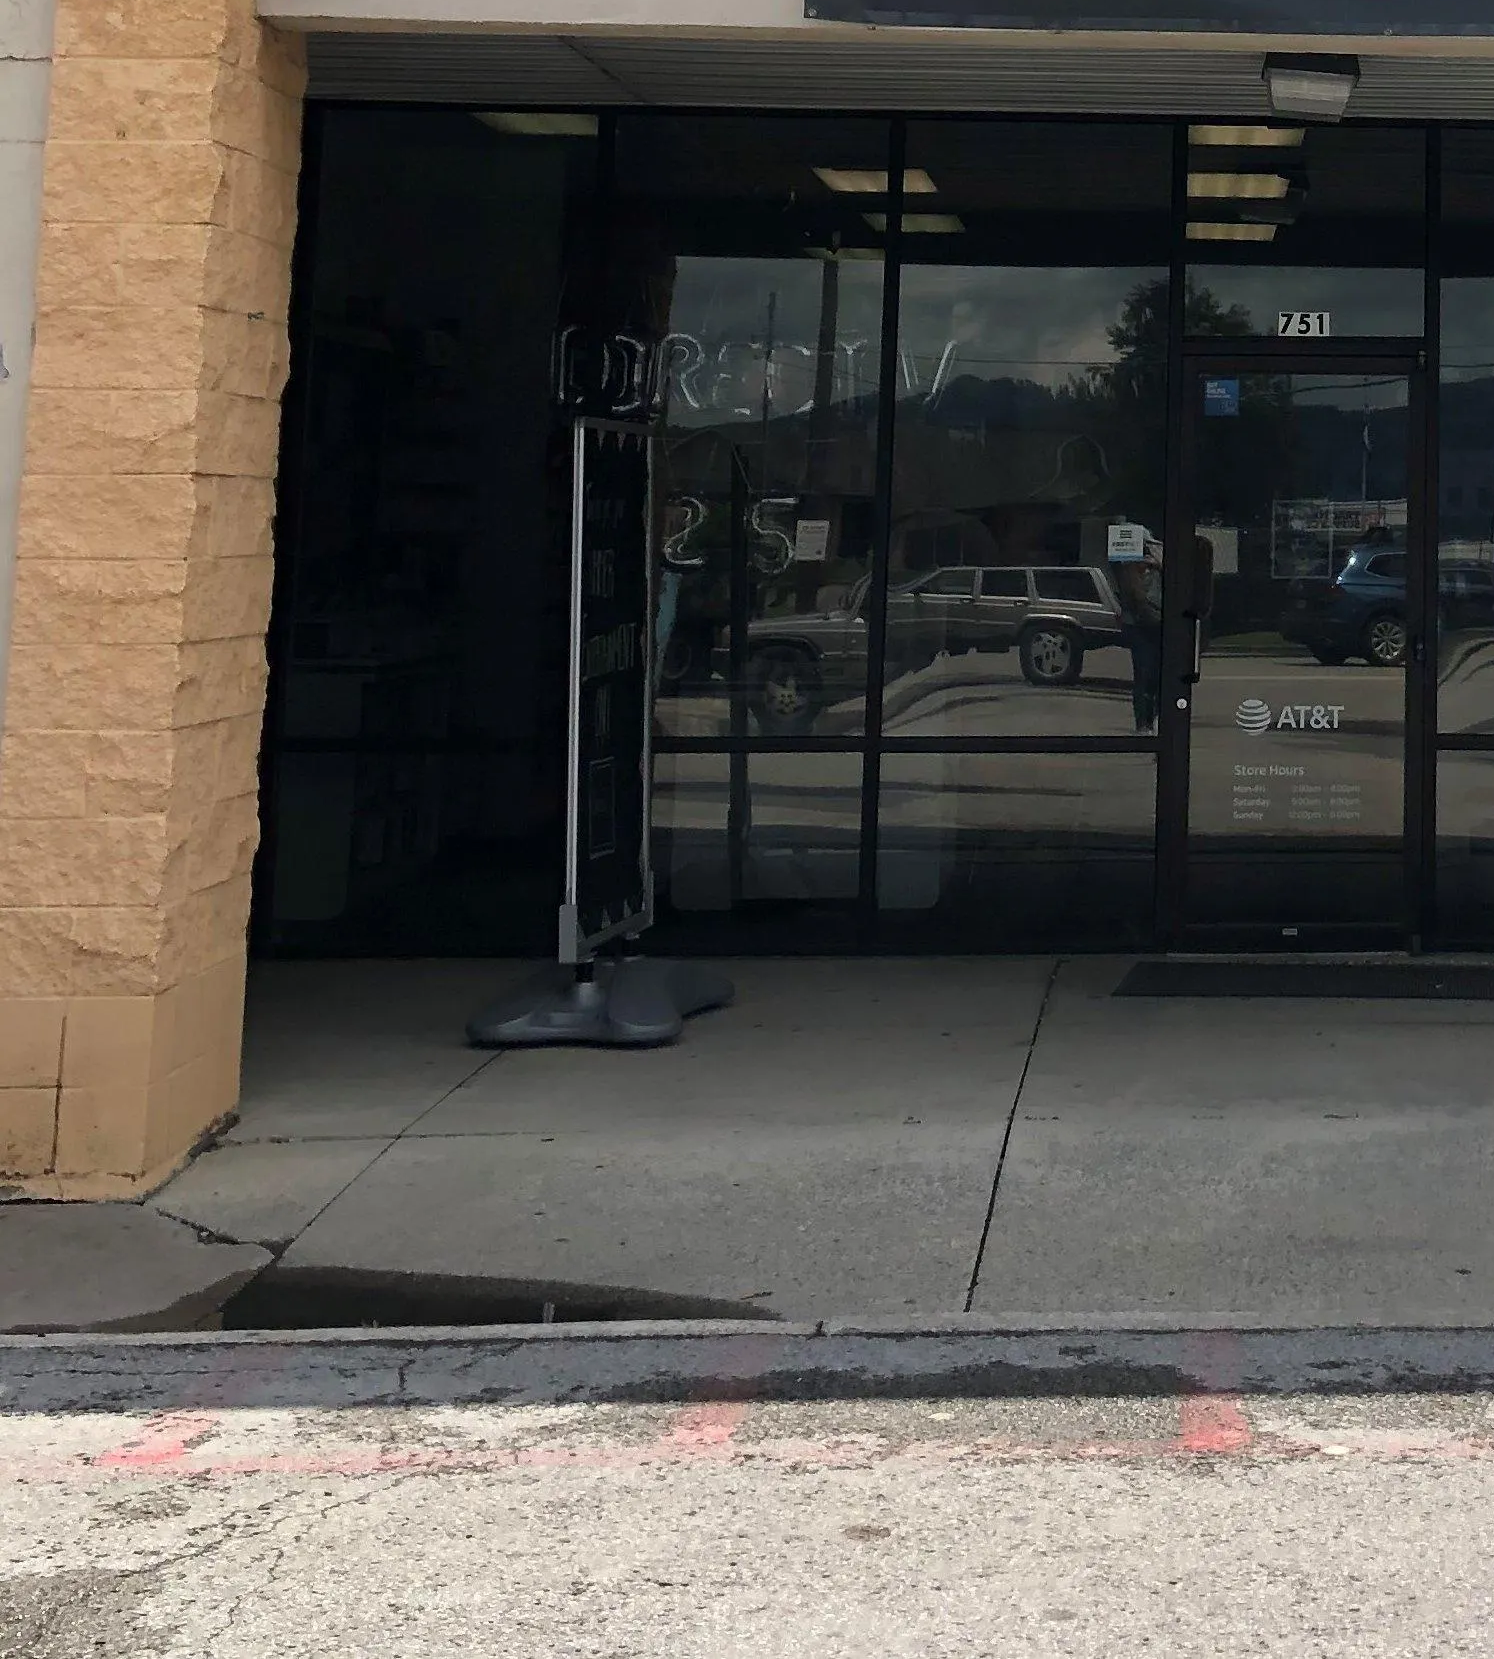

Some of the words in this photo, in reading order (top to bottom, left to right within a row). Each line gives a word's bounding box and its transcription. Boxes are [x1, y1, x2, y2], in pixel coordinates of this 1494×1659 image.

[1280, 313, 1325, 335] 751
[1276, 704, 1345, 729] AT&T
[1234, 764, 1267, 776] Store
[1269, 765, 1305, 776] Hours
